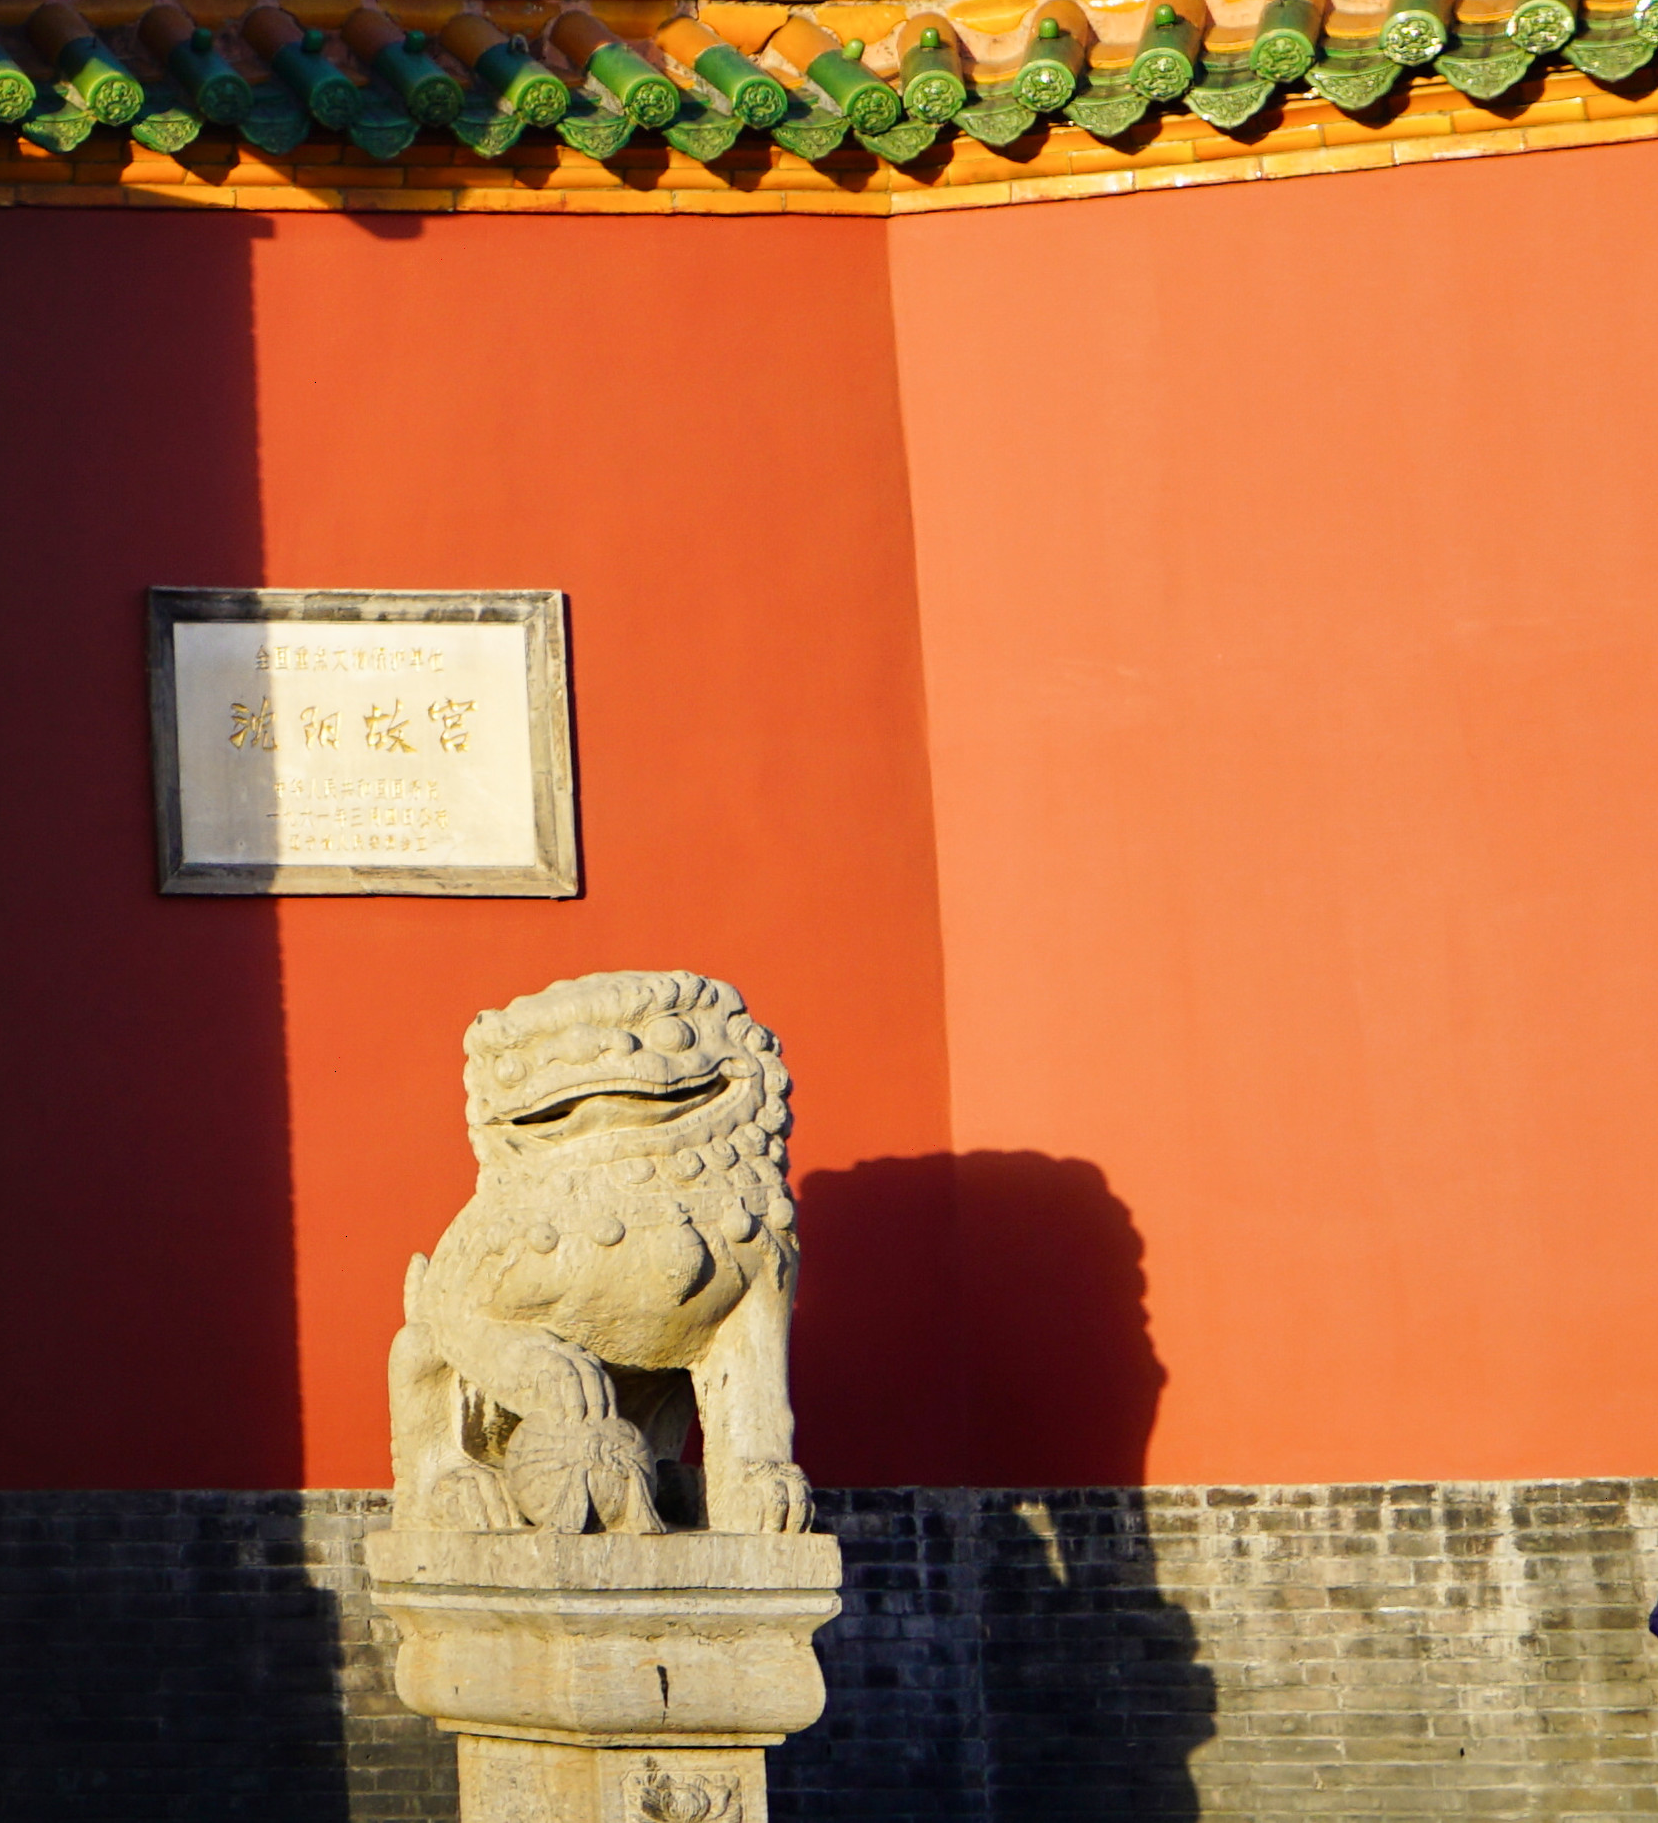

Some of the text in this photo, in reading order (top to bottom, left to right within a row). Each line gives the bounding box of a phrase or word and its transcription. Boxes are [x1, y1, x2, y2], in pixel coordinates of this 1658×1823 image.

[255, 644, 444, 672] 全国重点文物保护单位
[230, 696, 479, 754] 沈阳故宫
